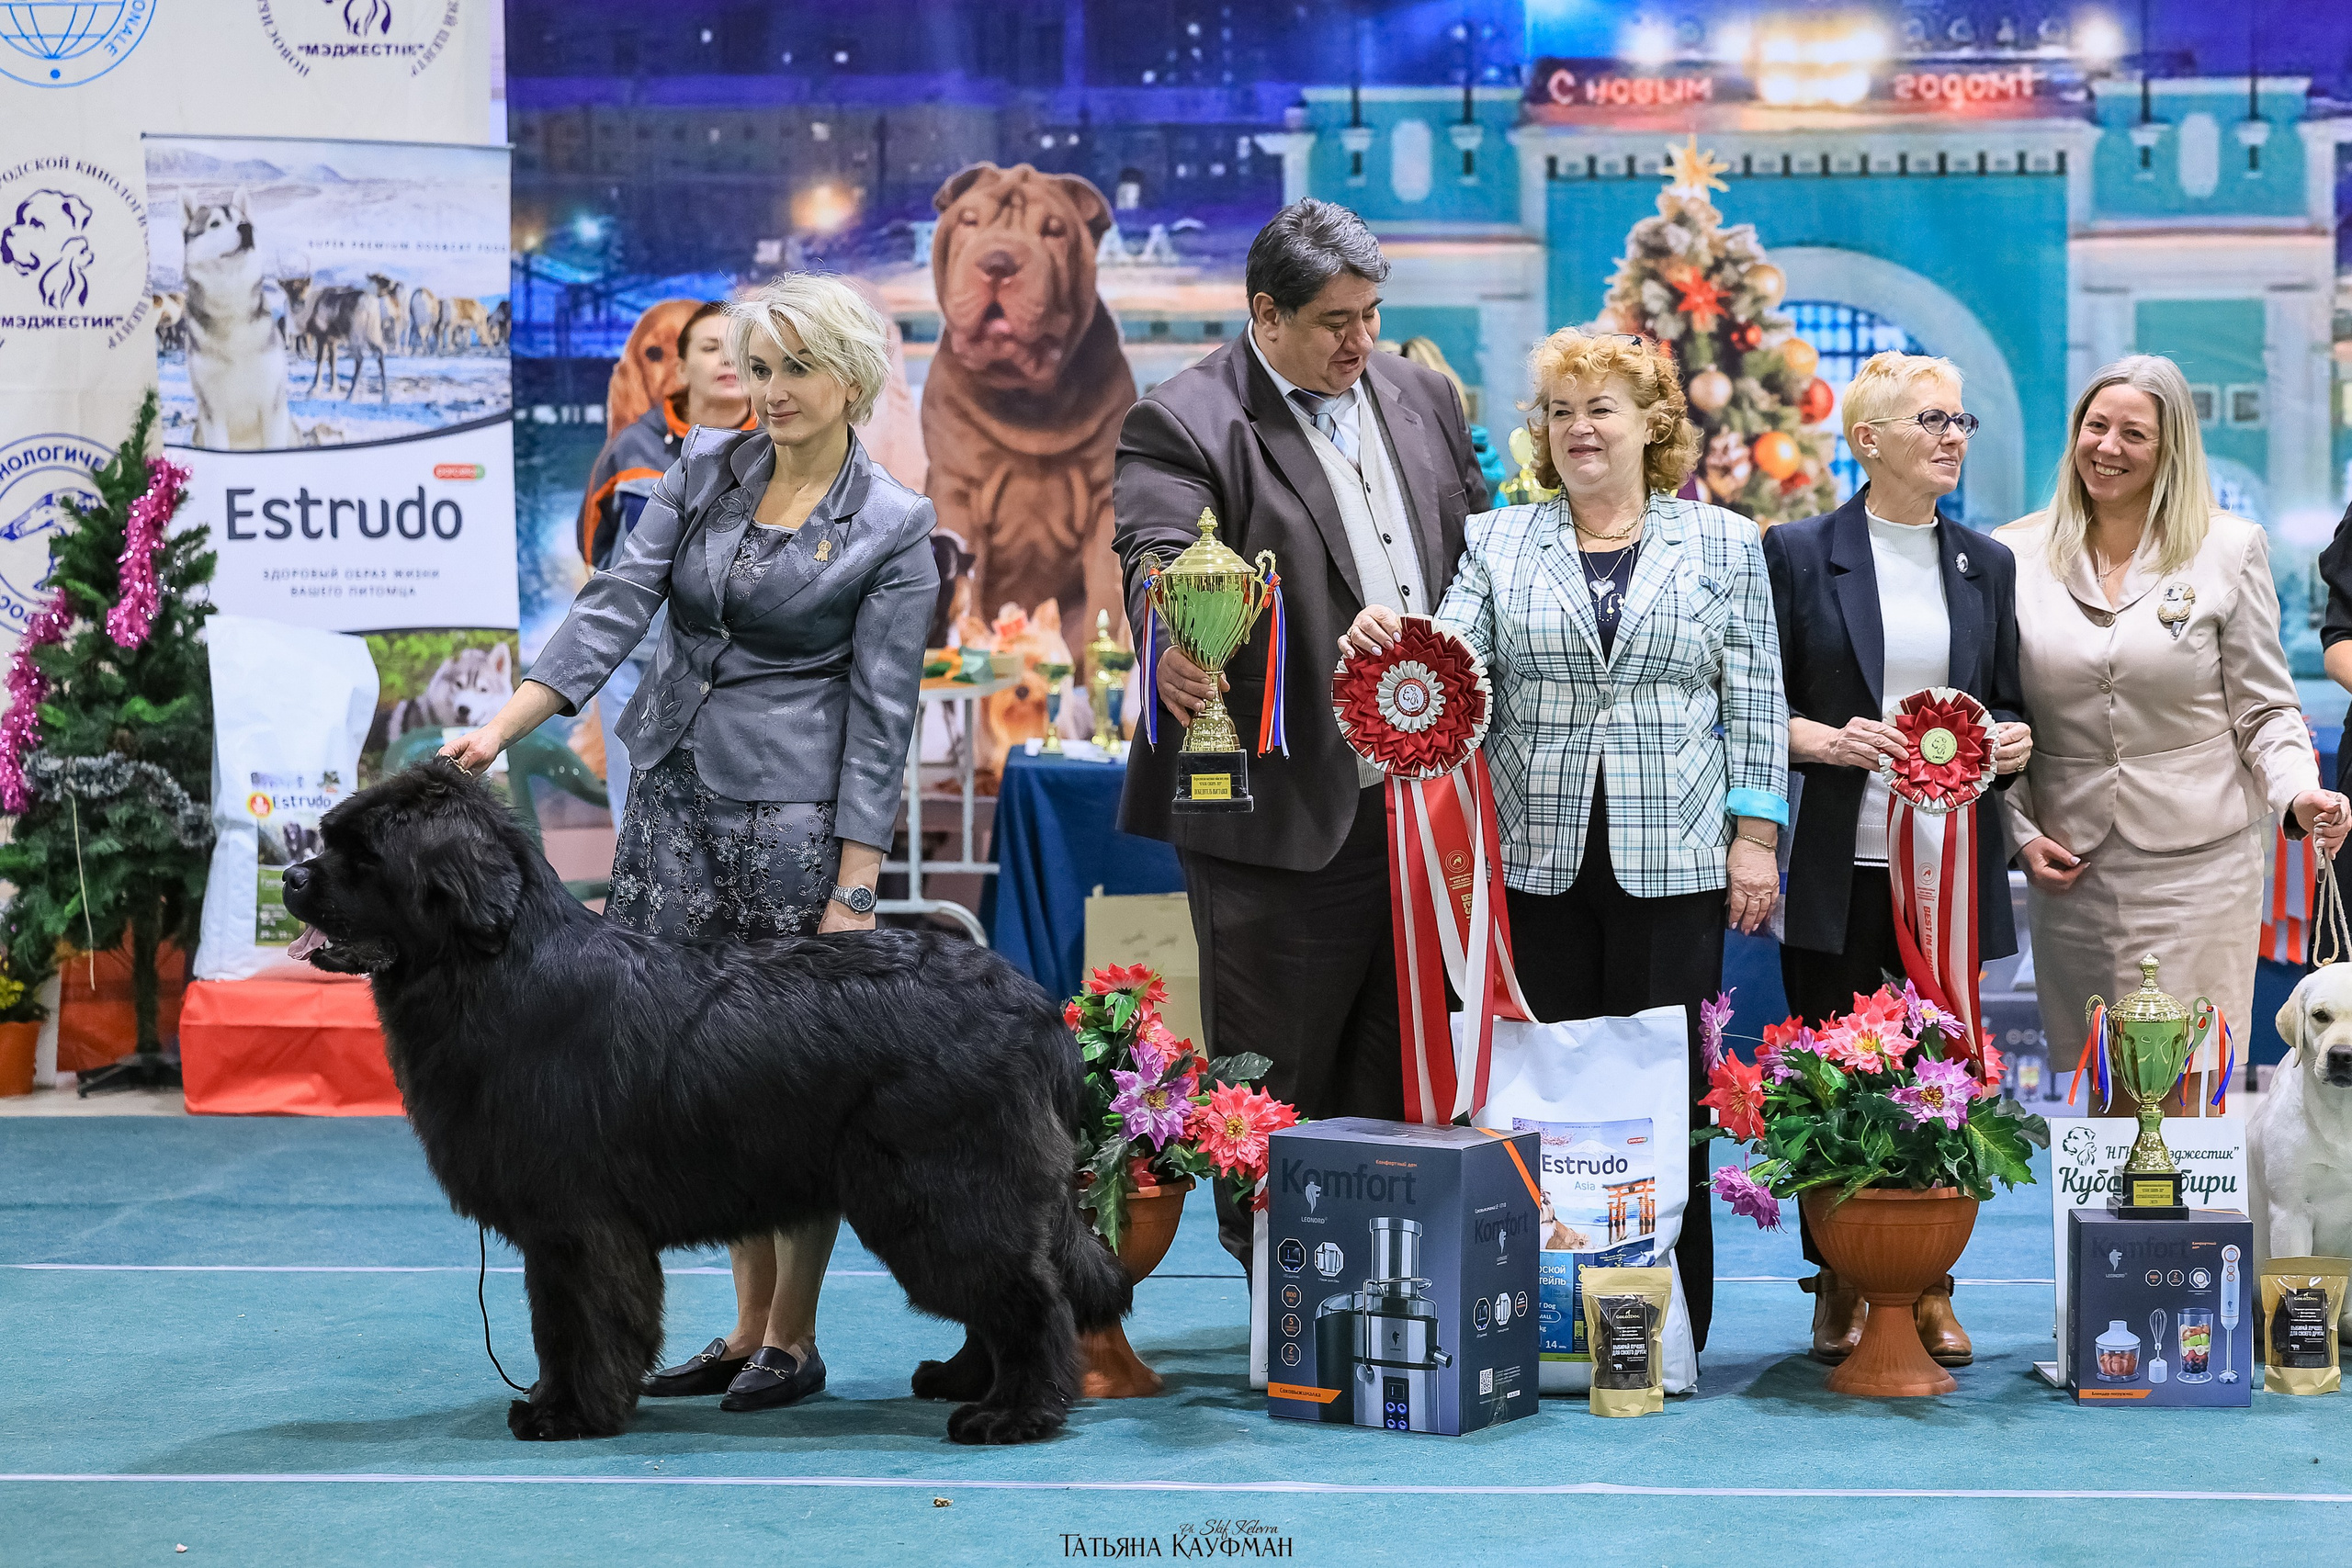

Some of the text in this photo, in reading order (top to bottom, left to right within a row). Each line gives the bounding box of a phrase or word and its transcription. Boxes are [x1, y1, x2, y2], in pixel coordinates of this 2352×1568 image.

[1547, 68, 1577, 106] С
[0, 156, 70, 184] ОДСКОЙ
[226, 484, 463, 540] Estrudo
[263, 566, 339, 581] ЗДОРОВЫЙ
[345, 568, 387, 580] ОБРАЗ
[272, 794, 332, 810] Estrudo
[1924, 906, 1933, 933] BEST
[1542, 1154, 1628, 1175] Estrudo
[2166, 1145, 2239, 1165] эджестик”
[1282, 1158, 1417, 1205] Komfort
[1574, 1180, 1596, 1191] Asia
[2180, 1169, 2238, 1204] бири
[1544, 1303, 1557, 1311] Dog
[1289, 1317, 1295, 1325] 5
[1288, 1347, 1294, 1355] 2
[1545, 1340, 1557, 1348] 14
